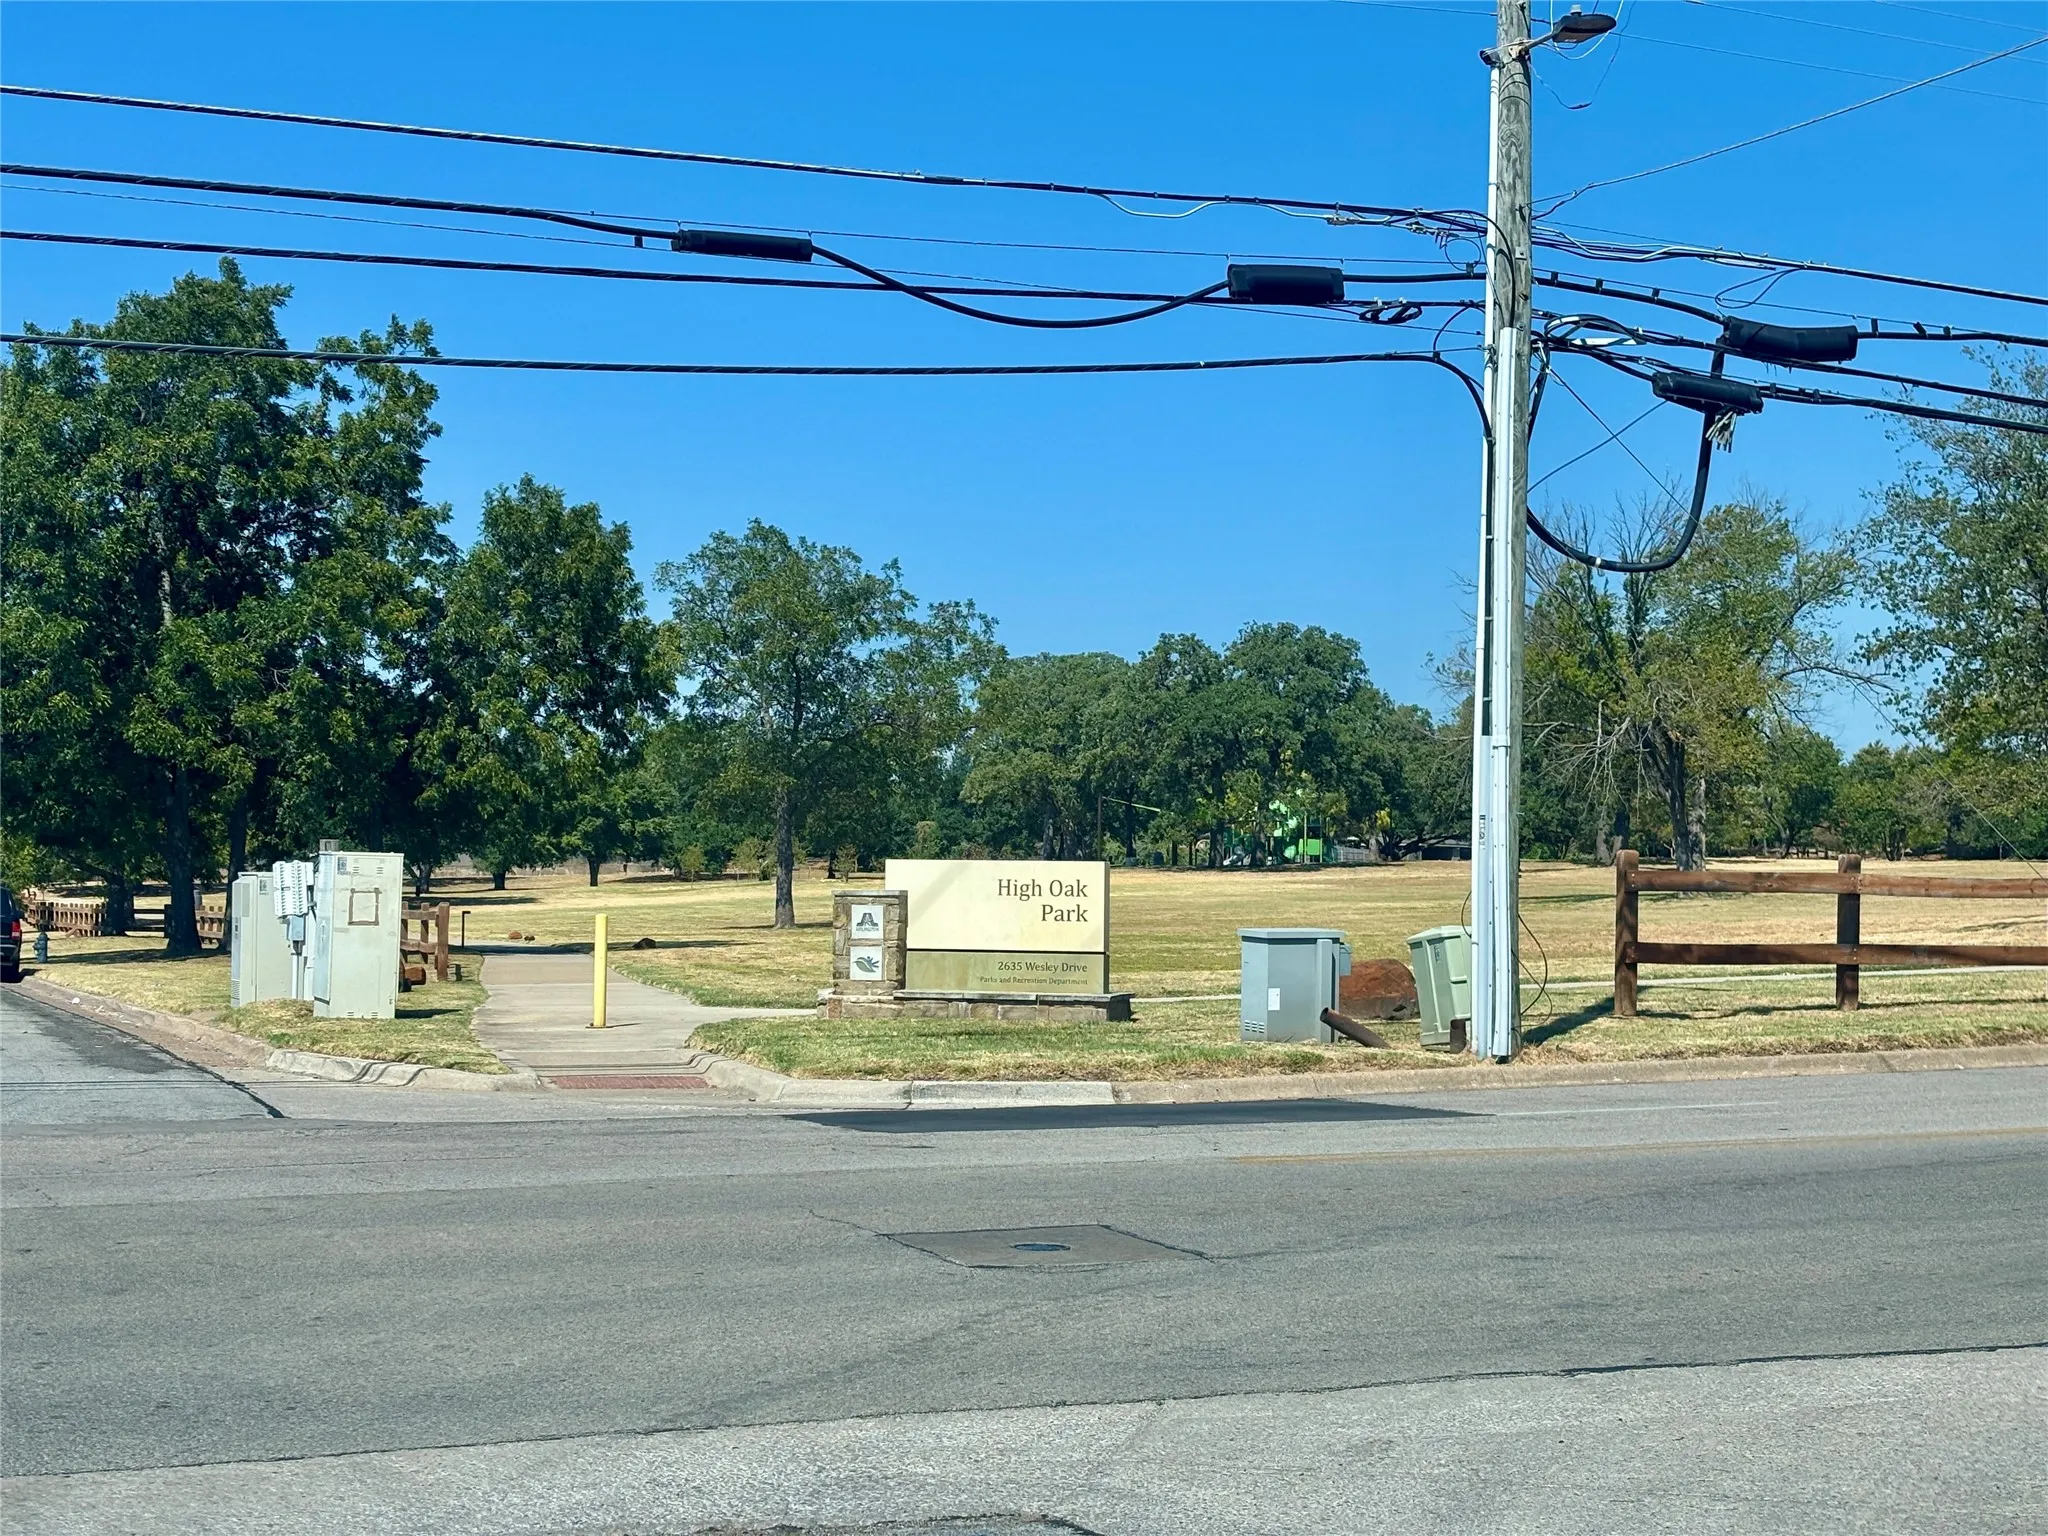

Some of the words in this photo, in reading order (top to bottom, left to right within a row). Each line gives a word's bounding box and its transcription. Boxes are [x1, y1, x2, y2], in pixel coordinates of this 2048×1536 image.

[997, 878, 1043, 902] High
[1049, 878, 1089, 898] Oak
[1041, 903, 1089, 922] Park
[997, 961, 1023, 971] 2635
[1024, 961, 1059, 973] Wesley
[1061, 962, 1088, 973] Drive
[979, 975, 998, 983] Parks
[999, 976, 1012, 984] and
[1012, 976, 1047, 984] Recreation
[1048, 977, 1088, 986] Department
